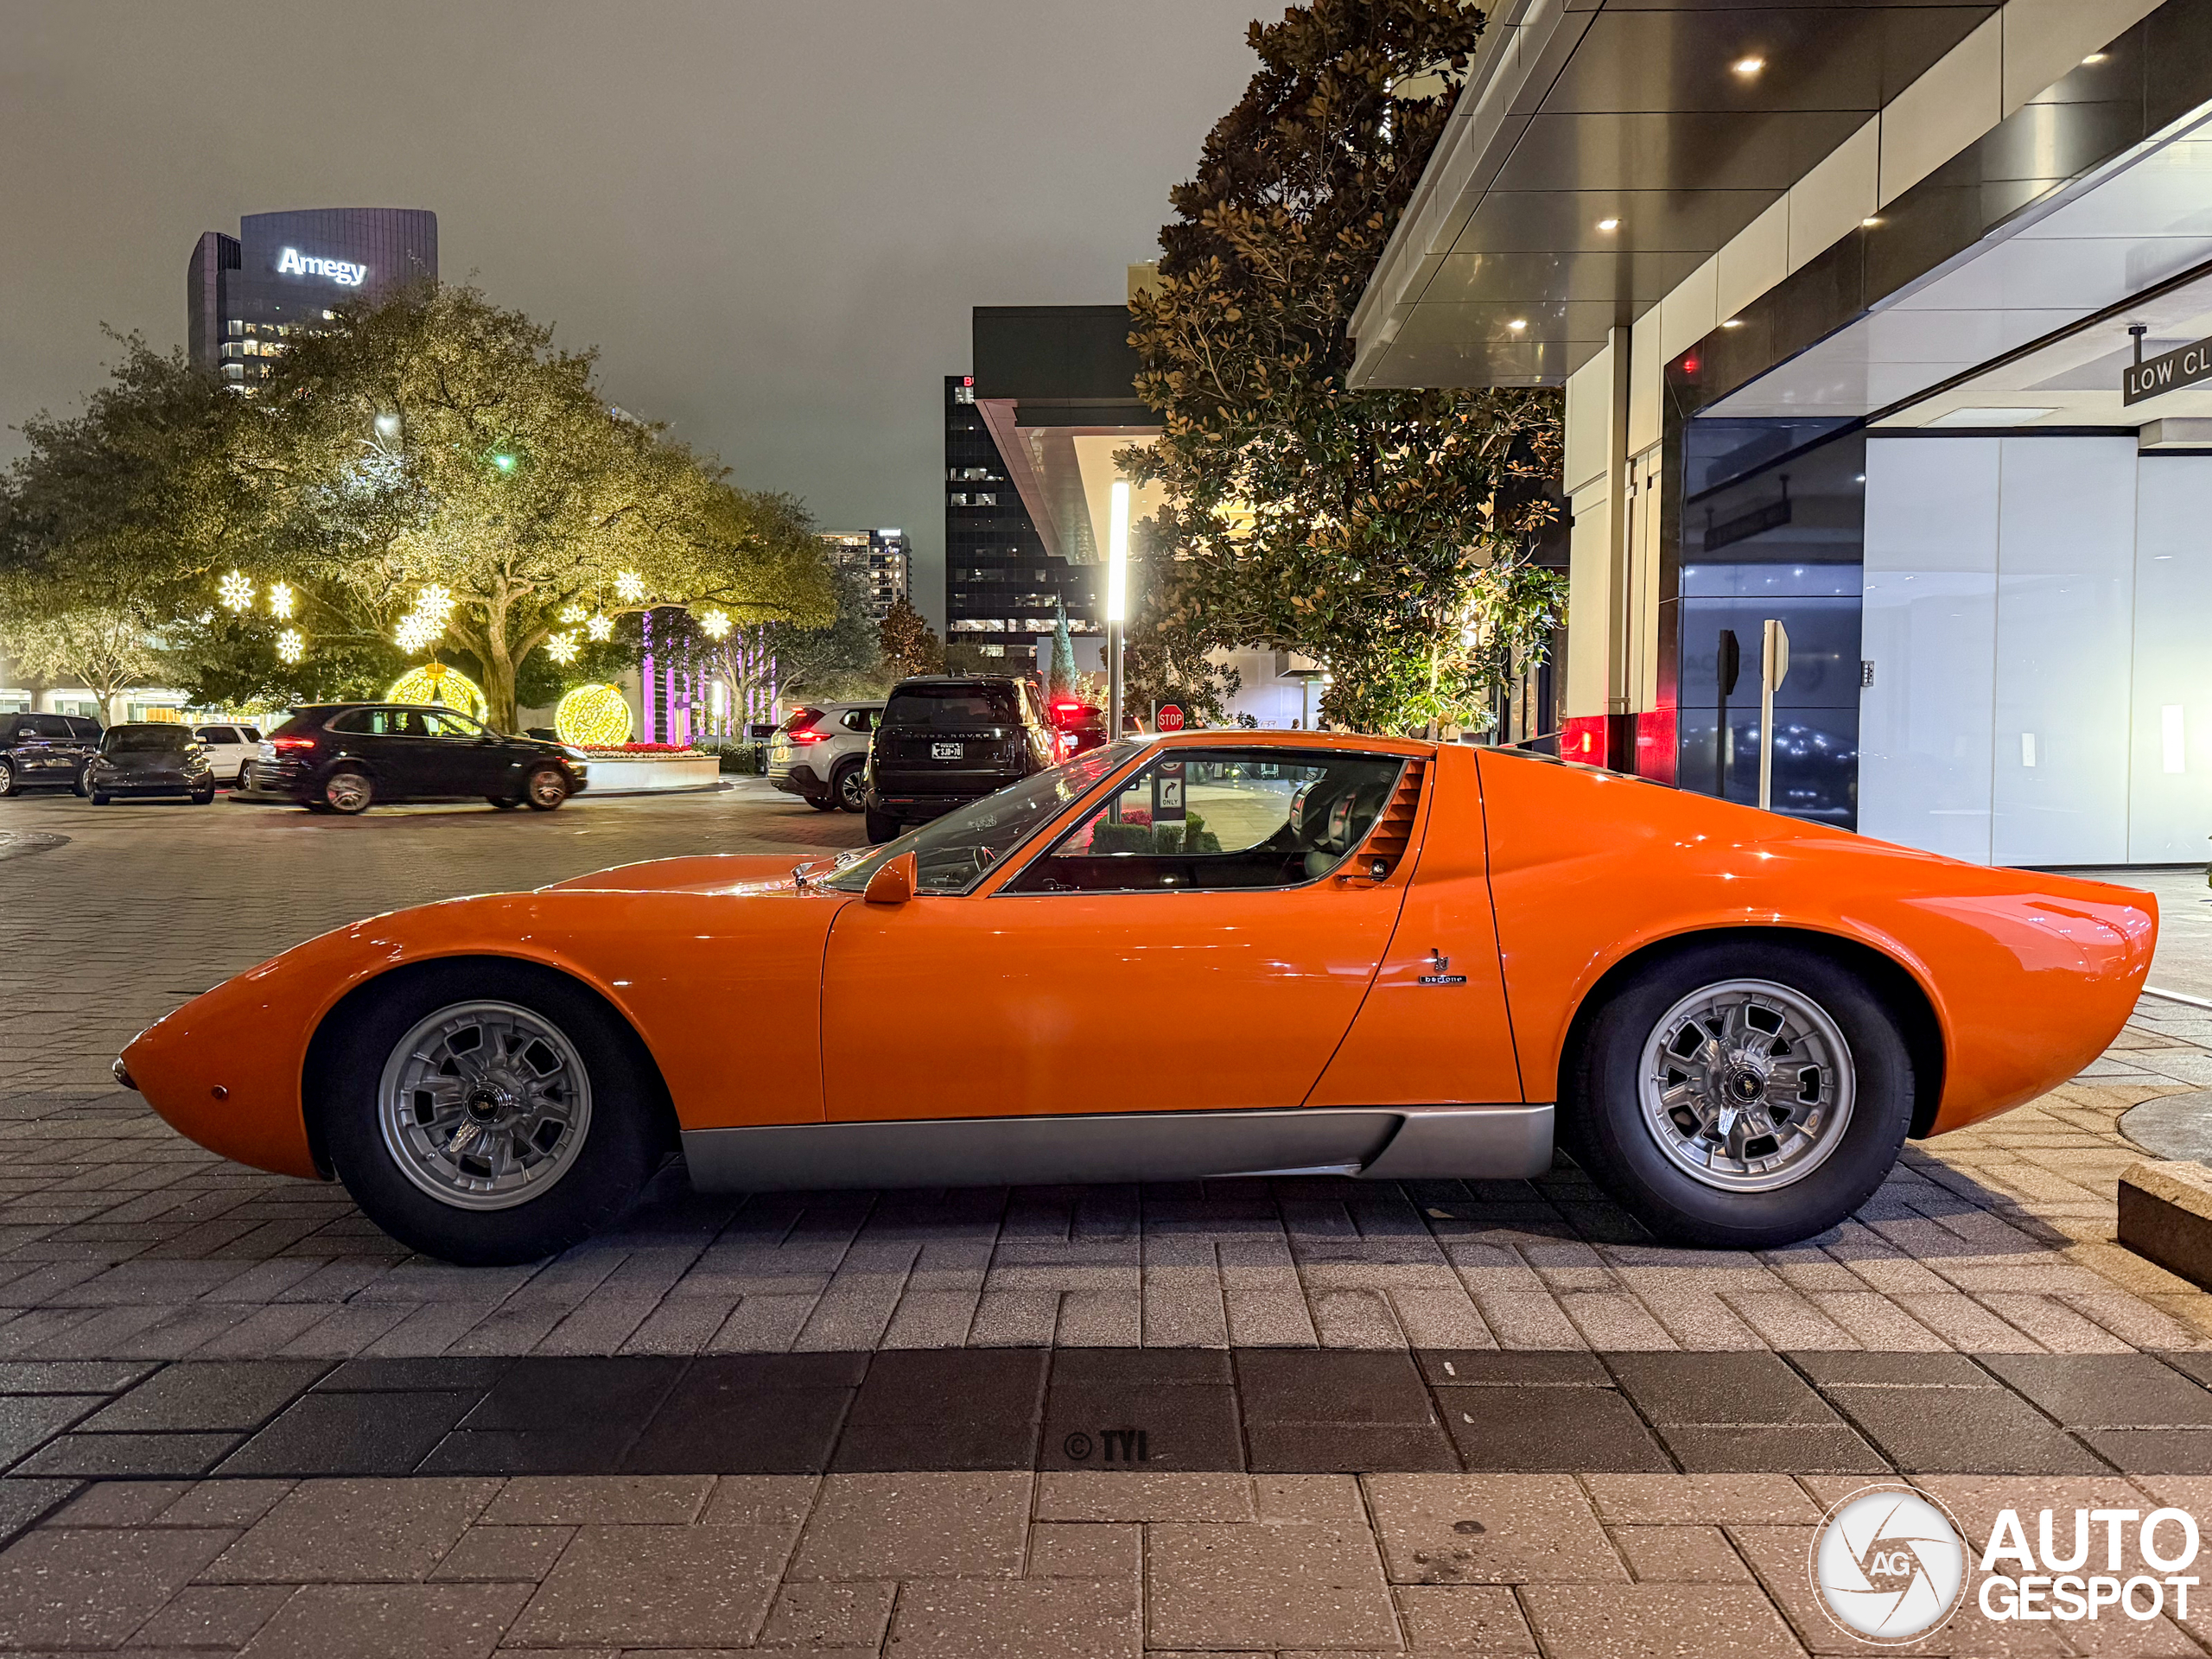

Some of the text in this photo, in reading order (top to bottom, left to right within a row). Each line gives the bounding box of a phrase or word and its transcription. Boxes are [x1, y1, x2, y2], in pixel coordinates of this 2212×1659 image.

[278, 248, 366, 286] Amegy
[2131, 359, 2174, 395] LOW
[1159, 714, 1183, 726] STOP
